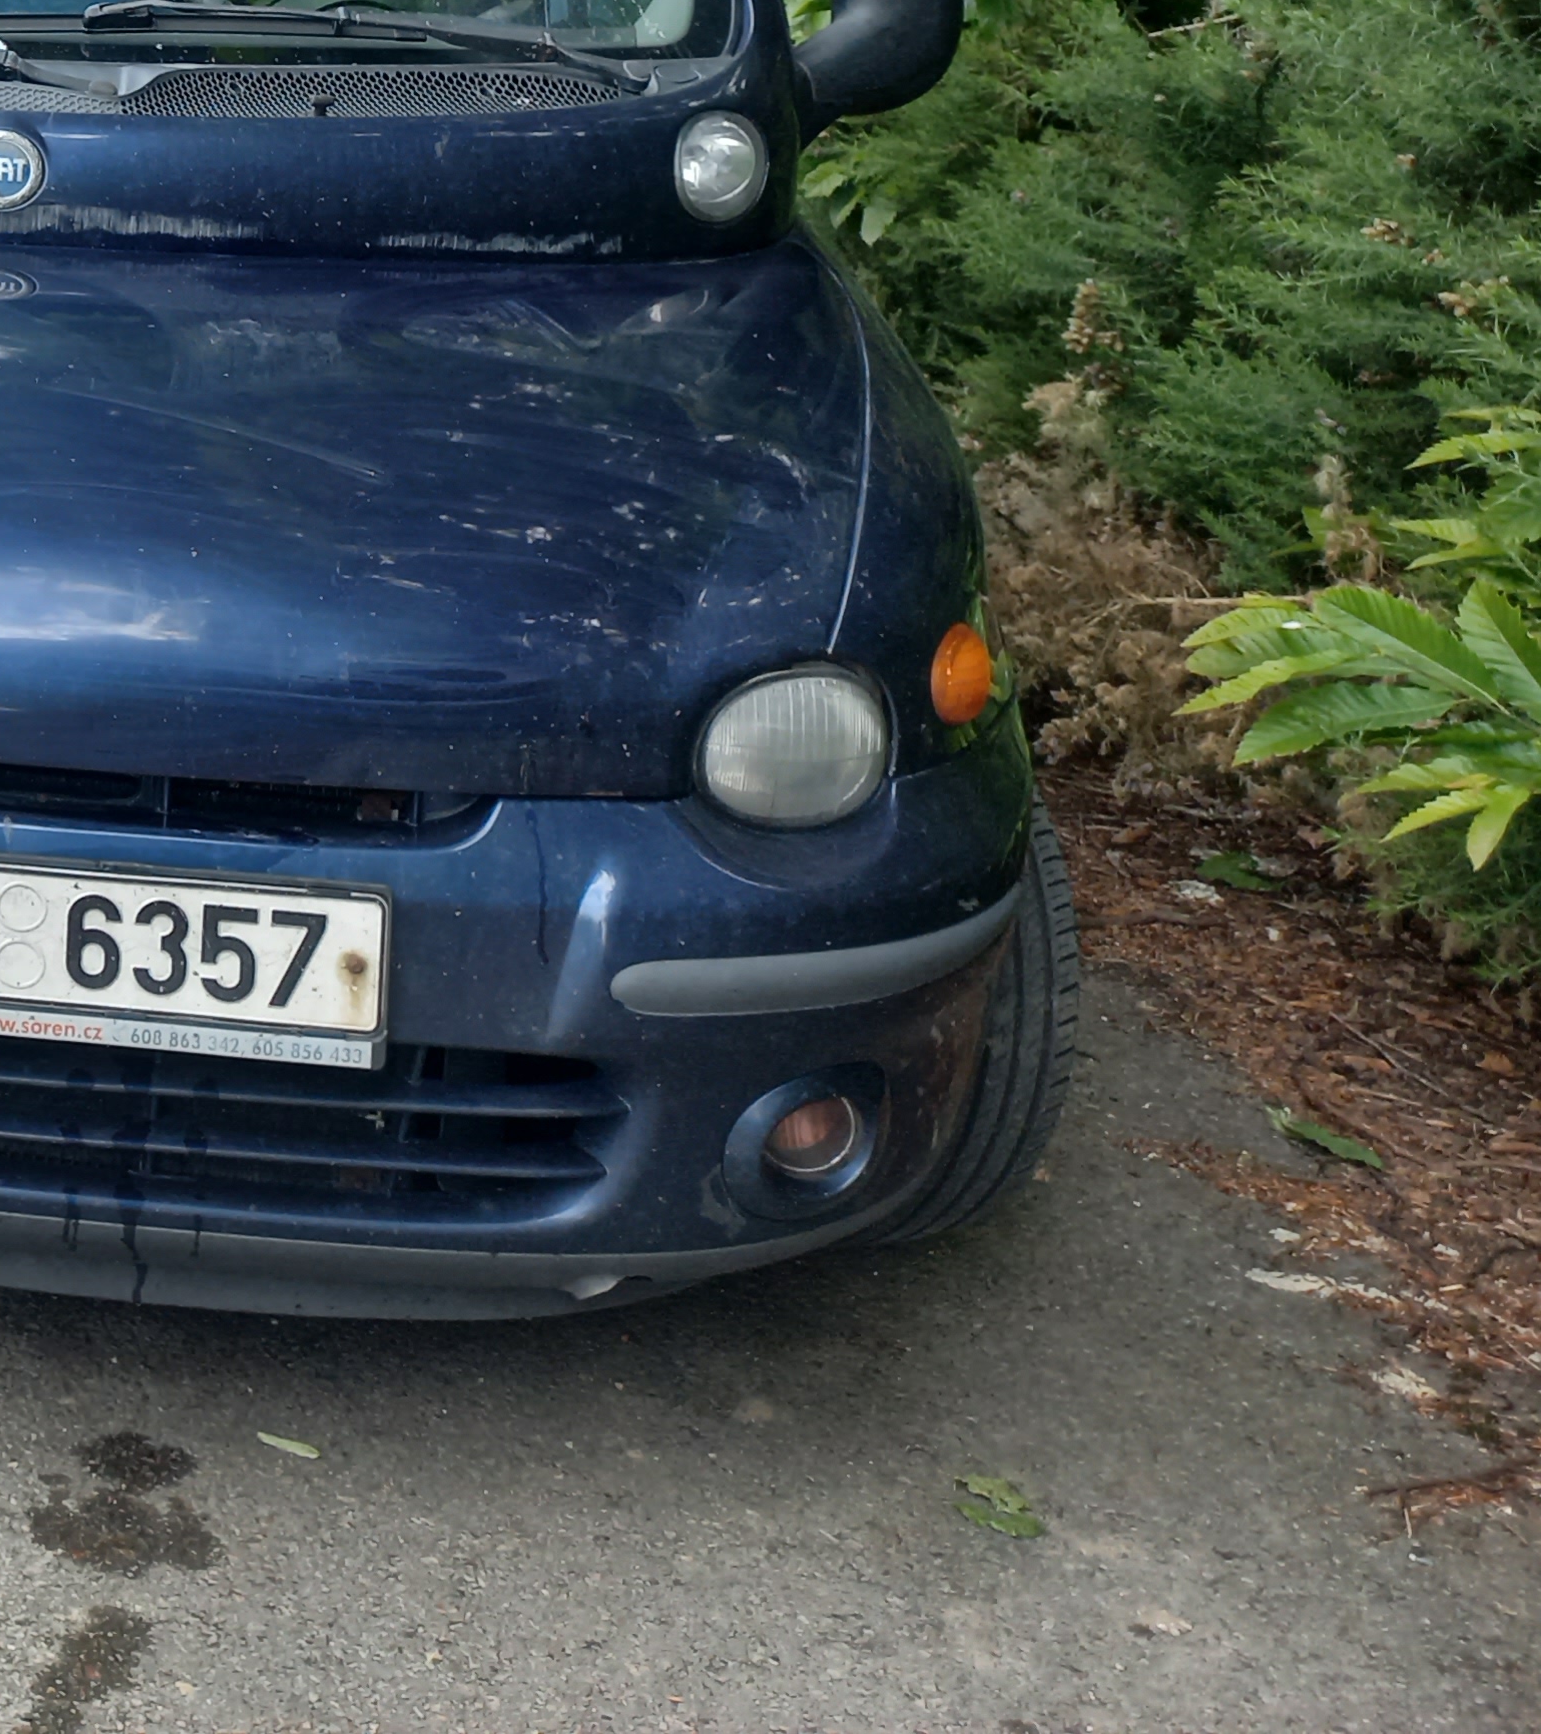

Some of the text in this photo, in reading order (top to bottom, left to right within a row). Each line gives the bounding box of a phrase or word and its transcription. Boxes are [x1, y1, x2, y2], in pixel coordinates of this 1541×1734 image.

[65, 894, 329, 1008] 6357
[169, 1033, 201, 1049] 863
[252, 1040, 284, 1057] 605
